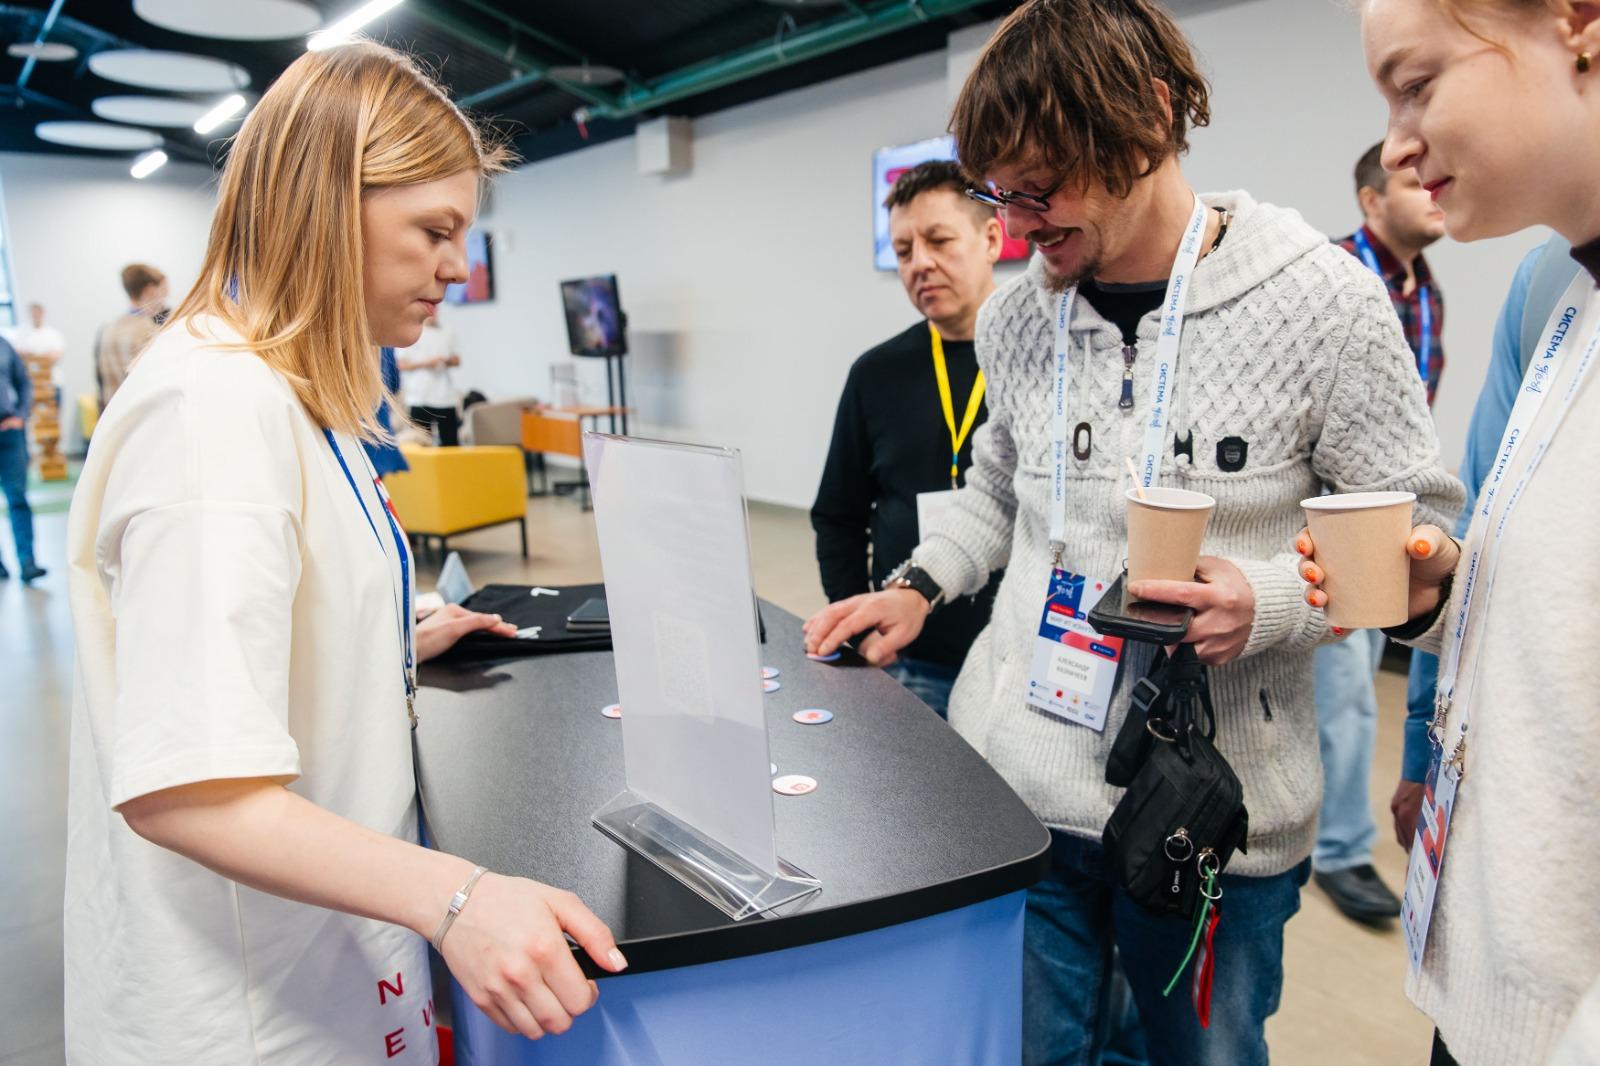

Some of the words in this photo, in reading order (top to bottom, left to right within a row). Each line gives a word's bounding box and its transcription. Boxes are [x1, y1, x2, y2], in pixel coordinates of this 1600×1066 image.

[1169, 274, 1184, 312] СИСТЕМА
[1543, 306, 1577, 359] СИСТЕМА
[1155, 362, 1169, 404] СИСТЕМА
[1143, 453, 1156, 488] СИСТЕМ
[1494, 427, 1521, 483] СИСТЕМА
[1463, 551, 1478, 606] СИСТЕМА
[377, 972, 403, 1005] N
[384, 1026, 406, 1058] E
